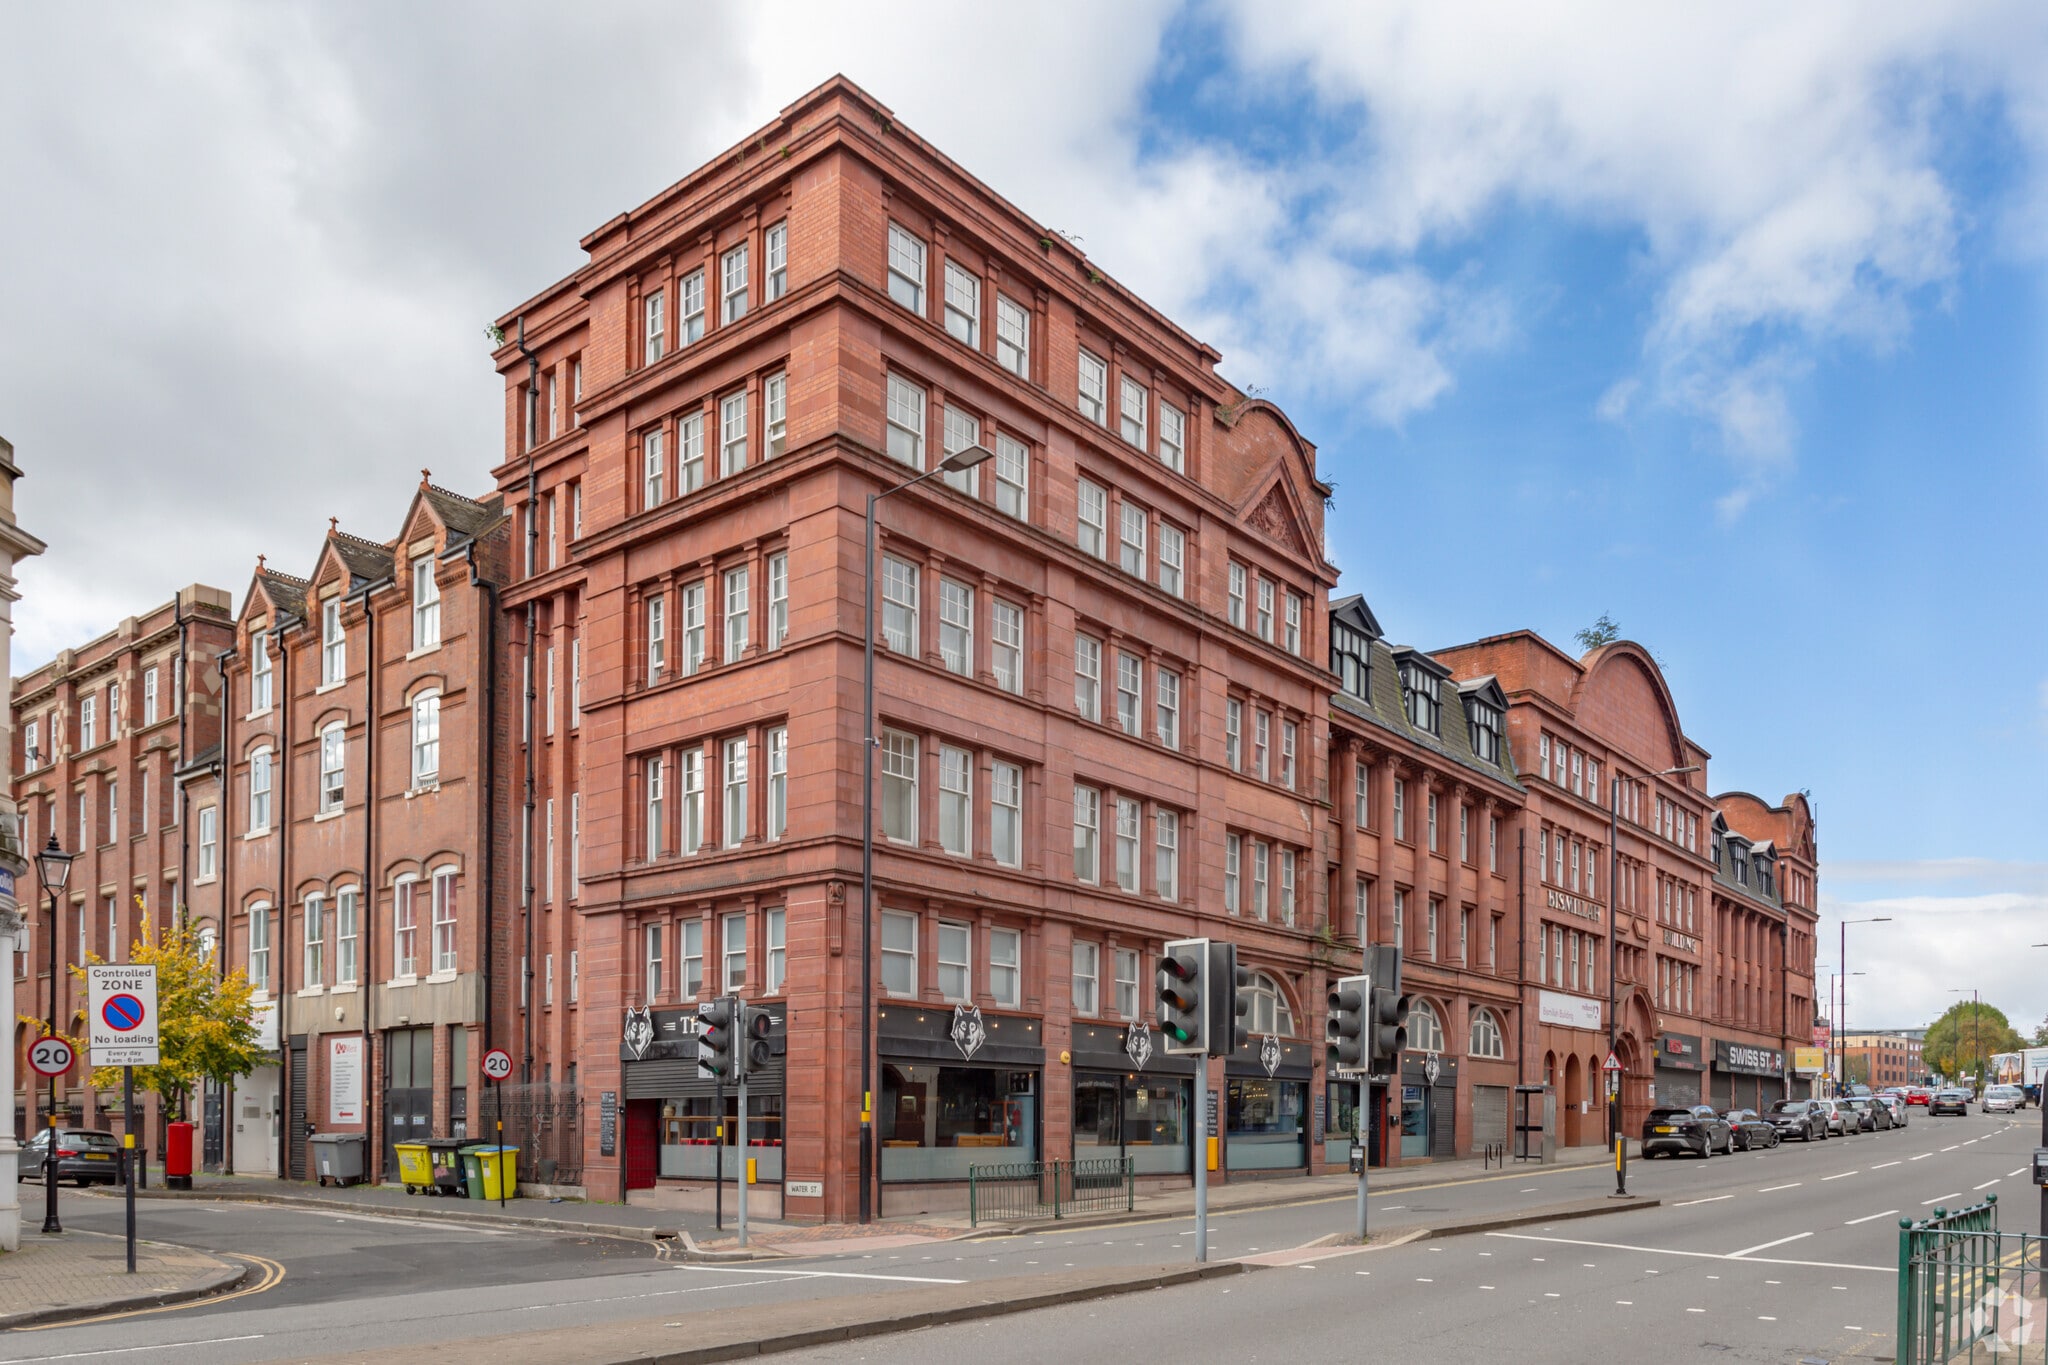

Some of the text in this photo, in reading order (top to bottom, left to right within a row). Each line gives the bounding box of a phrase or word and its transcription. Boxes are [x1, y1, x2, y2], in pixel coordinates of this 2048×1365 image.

[93, 969, 151, 978] Controlled
[102, 980, 143, 990] ZONE
[680, 1014, 699, 1034] TH
[95, 1035, 154, 1044] No loading
[36, 1048, 69, 1065] 20
[1730, 1046, 1758, 1067] SWISS
[488, 1058, 509, 1071] 20
[791, 1185, 808, 1193] WATER
